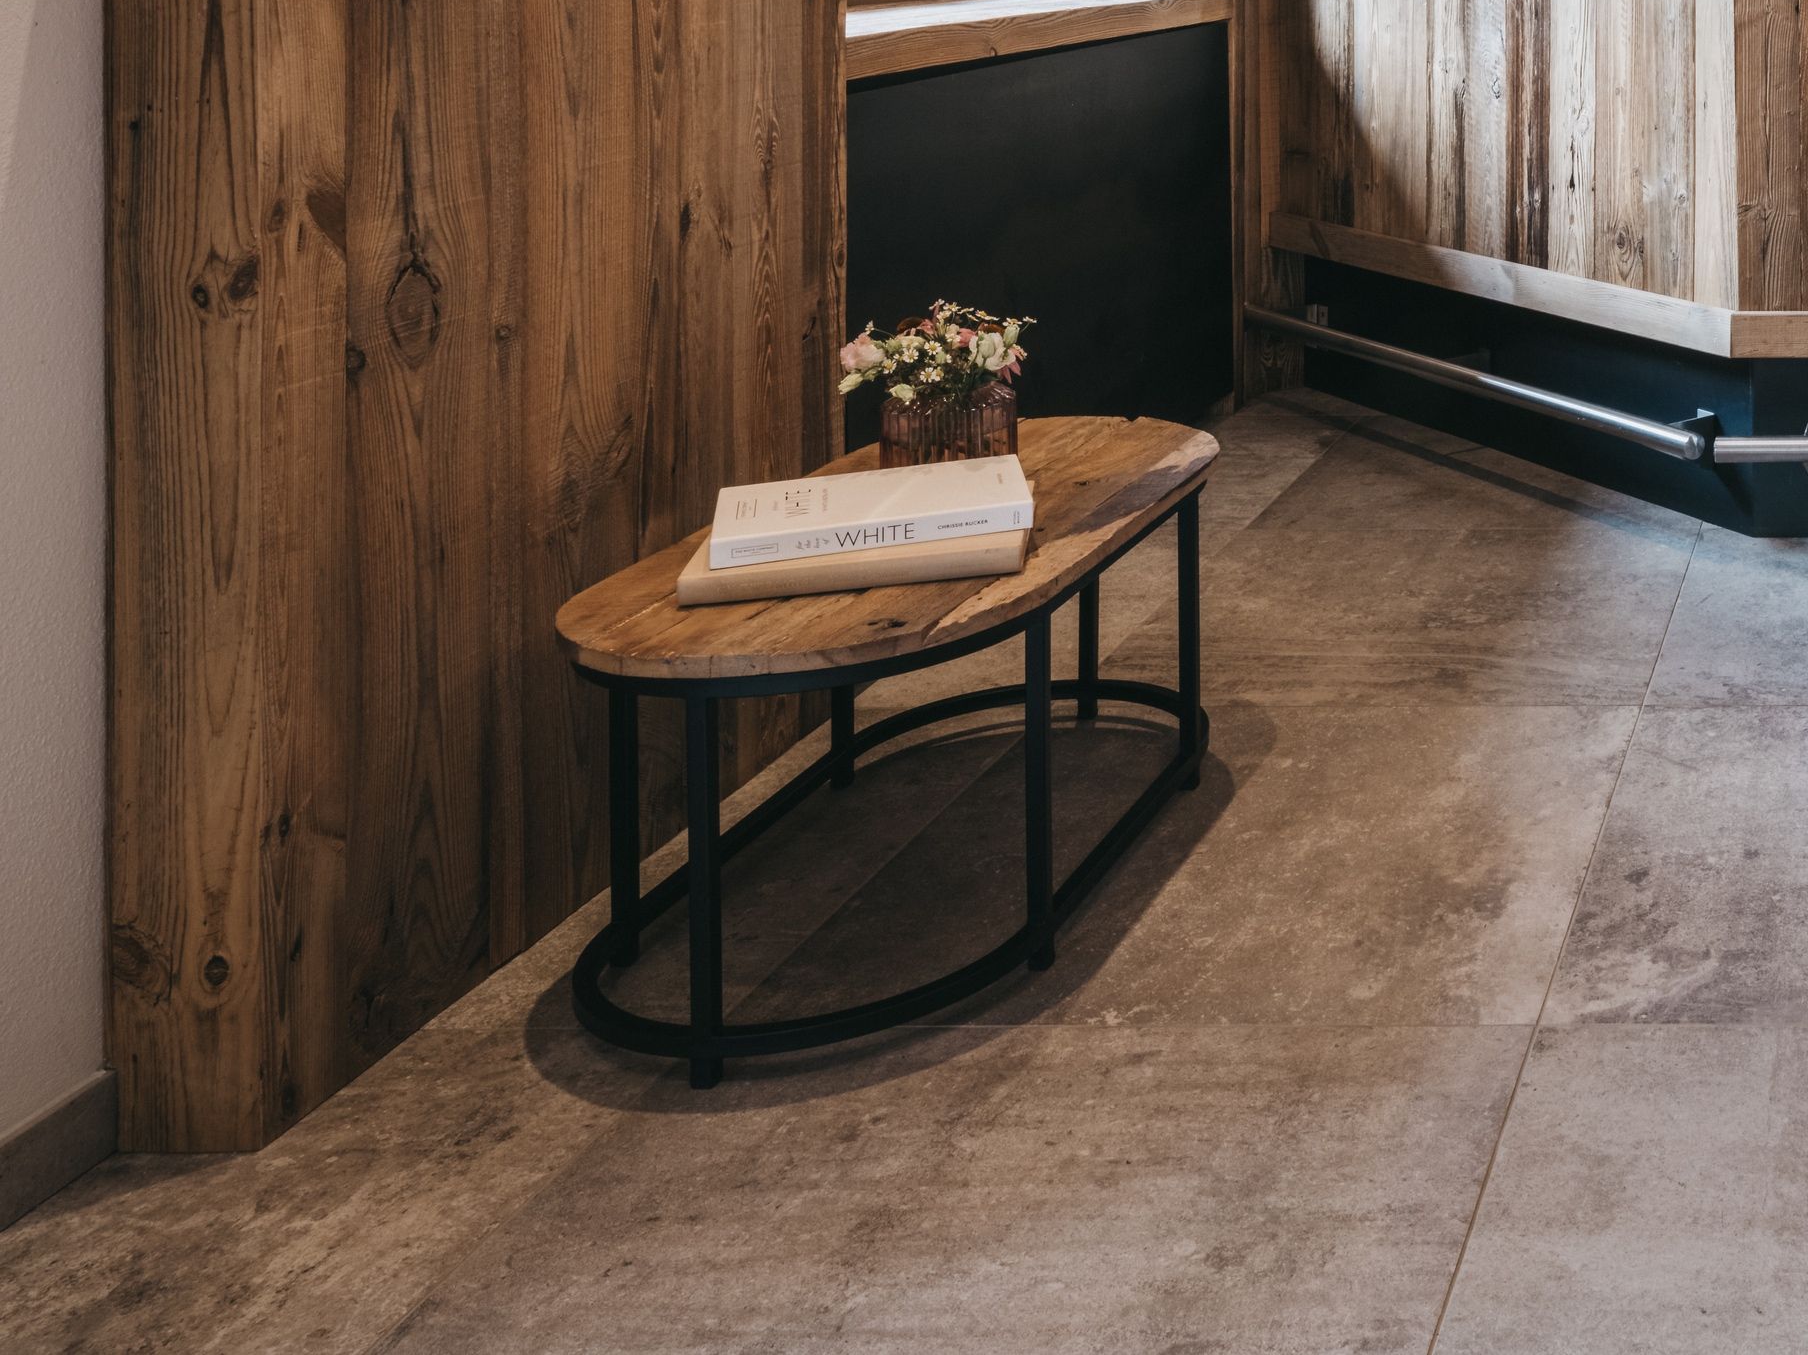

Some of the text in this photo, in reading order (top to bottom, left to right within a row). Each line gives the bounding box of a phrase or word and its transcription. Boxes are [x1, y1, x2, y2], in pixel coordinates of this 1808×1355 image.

[835, 522, 915, 548] WHITE
[937, 522, 964, 531] CHRISSIE
[965, 518, 989, 527] RUCKER
